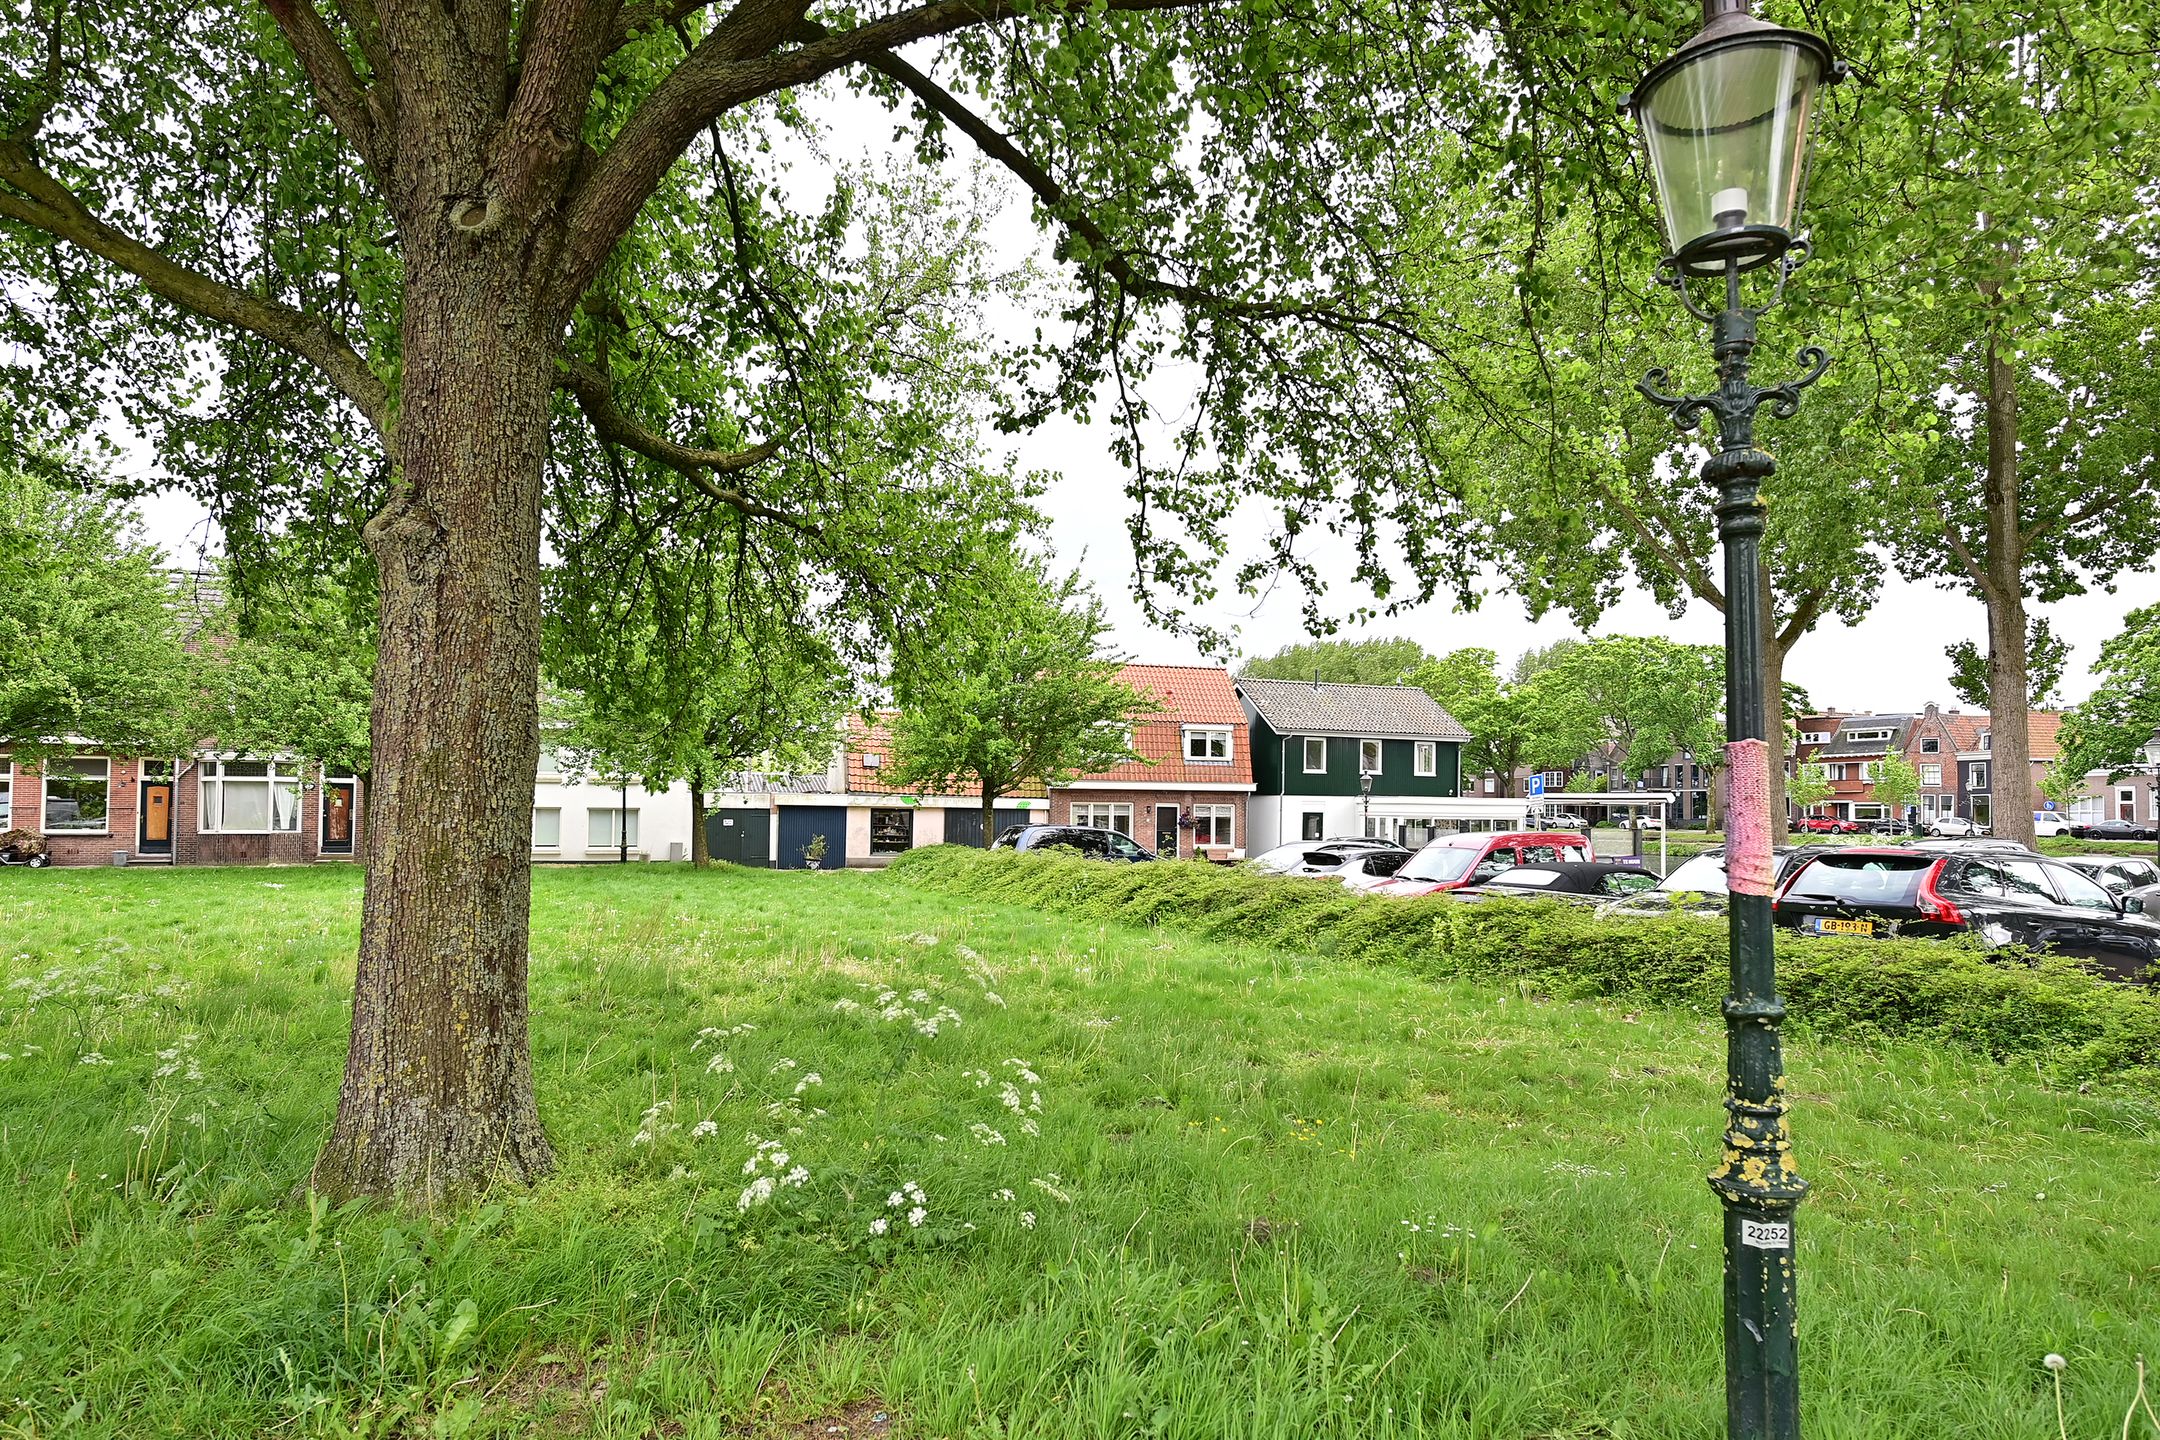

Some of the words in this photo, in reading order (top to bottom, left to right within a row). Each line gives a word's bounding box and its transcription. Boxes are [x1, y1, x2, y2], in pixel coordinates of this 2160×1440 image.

[1531, 777, 1541, 794] P
[1809, 905, 1871, 915] VOVO
[1747, 1225, 1788, 1241] 22252
